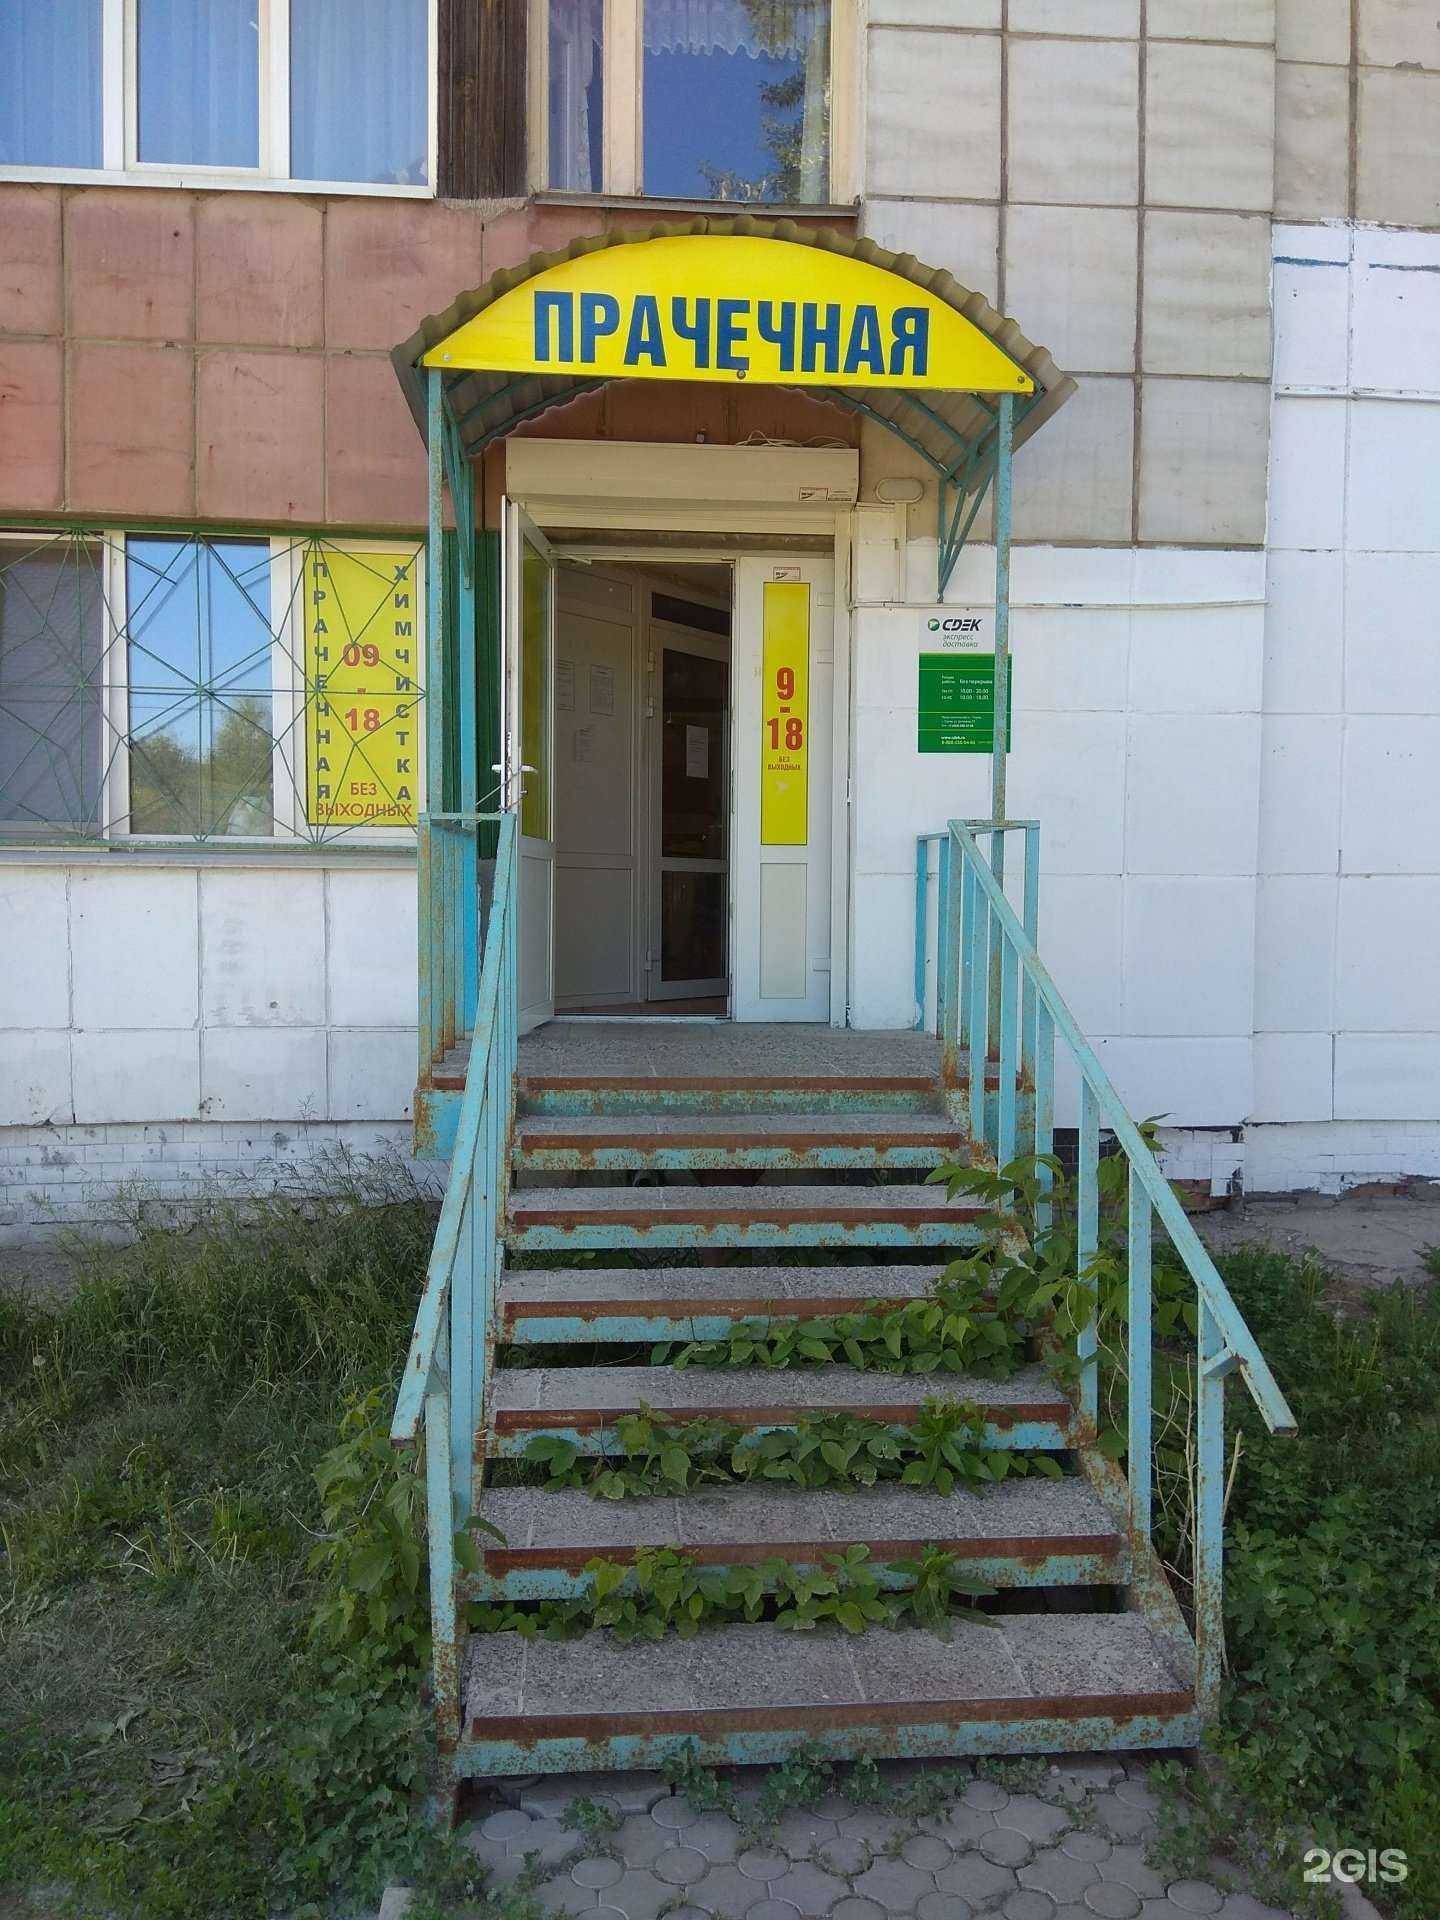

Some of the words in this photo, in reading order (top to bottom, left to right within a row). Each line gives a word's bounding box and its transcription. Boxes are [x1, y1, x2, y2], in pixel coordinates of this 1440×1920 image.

[533, 290, 930, 377] ПРАЧЕЧНАЯ
[942, 618, 983, 631] CDEK
[343, 643, 379, 667] 09
[312, 562, 331, 799] ПРАЧЕЧНАЯ
[394, 565, 412, 800] ХИМЧИСТКА
[776, 666, 795, 701] 9
[345, 708, 380, 731] 18
[767, 717, 803, 750] 18
[350, 782, 377, 796] БЕЗ
[316, 803, 412, 817] ВЫХОДНЫХ
